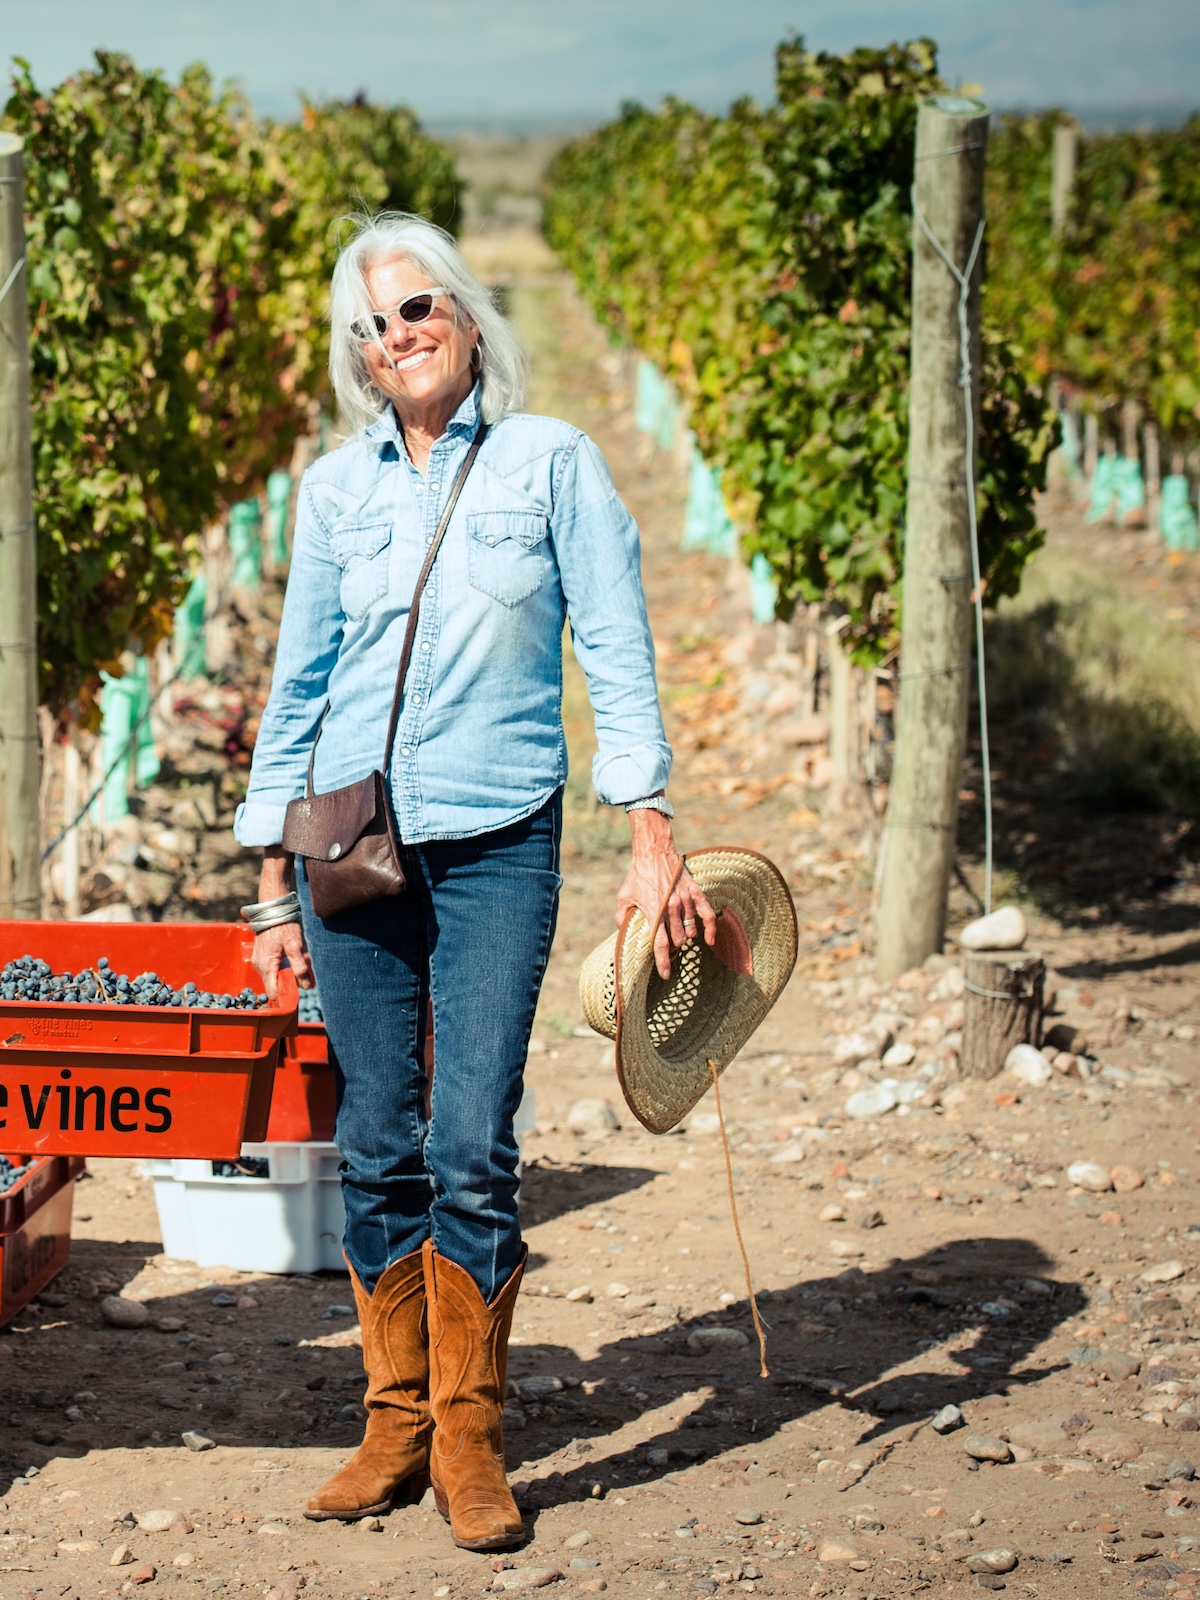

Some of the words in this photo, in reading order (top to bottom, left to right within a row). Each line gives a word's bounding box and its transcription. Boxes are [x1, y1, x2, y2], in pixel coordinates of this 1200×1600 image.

[42, 1018, 59, 1029] the
[64, 1019, 93, 1030] vines
[20, 1069, 172, 1133] vines
